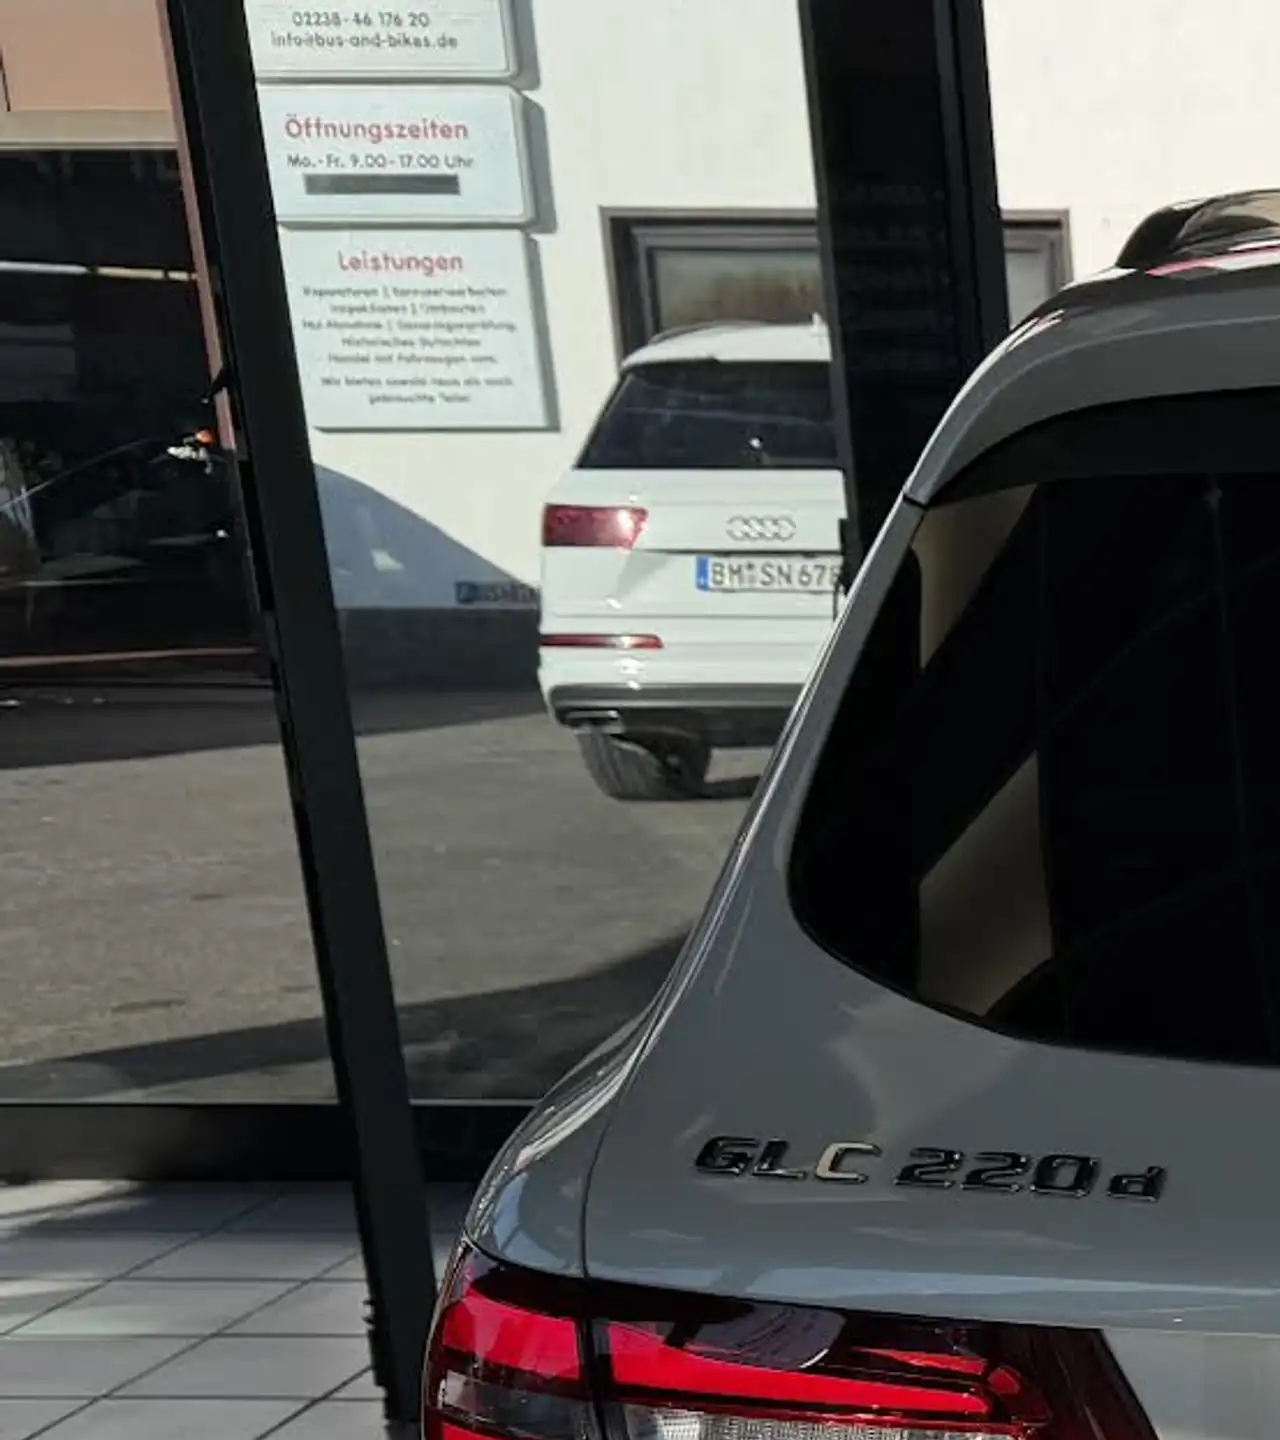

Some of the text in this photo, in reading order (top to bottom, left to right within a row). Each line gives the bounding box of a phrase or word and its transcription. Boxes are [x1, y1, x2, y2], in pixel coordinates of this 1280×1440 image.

[407, 11, 431, 27] 20
[284, 113, 469, 145] Öffnungszeiten
[444, 152, 475, 168] Uhr
[337, 249, 465, 277] Leistungen
[759, 562, 793, 587] SN
[693, 1135, 1169, 1203] GLC 220 d
